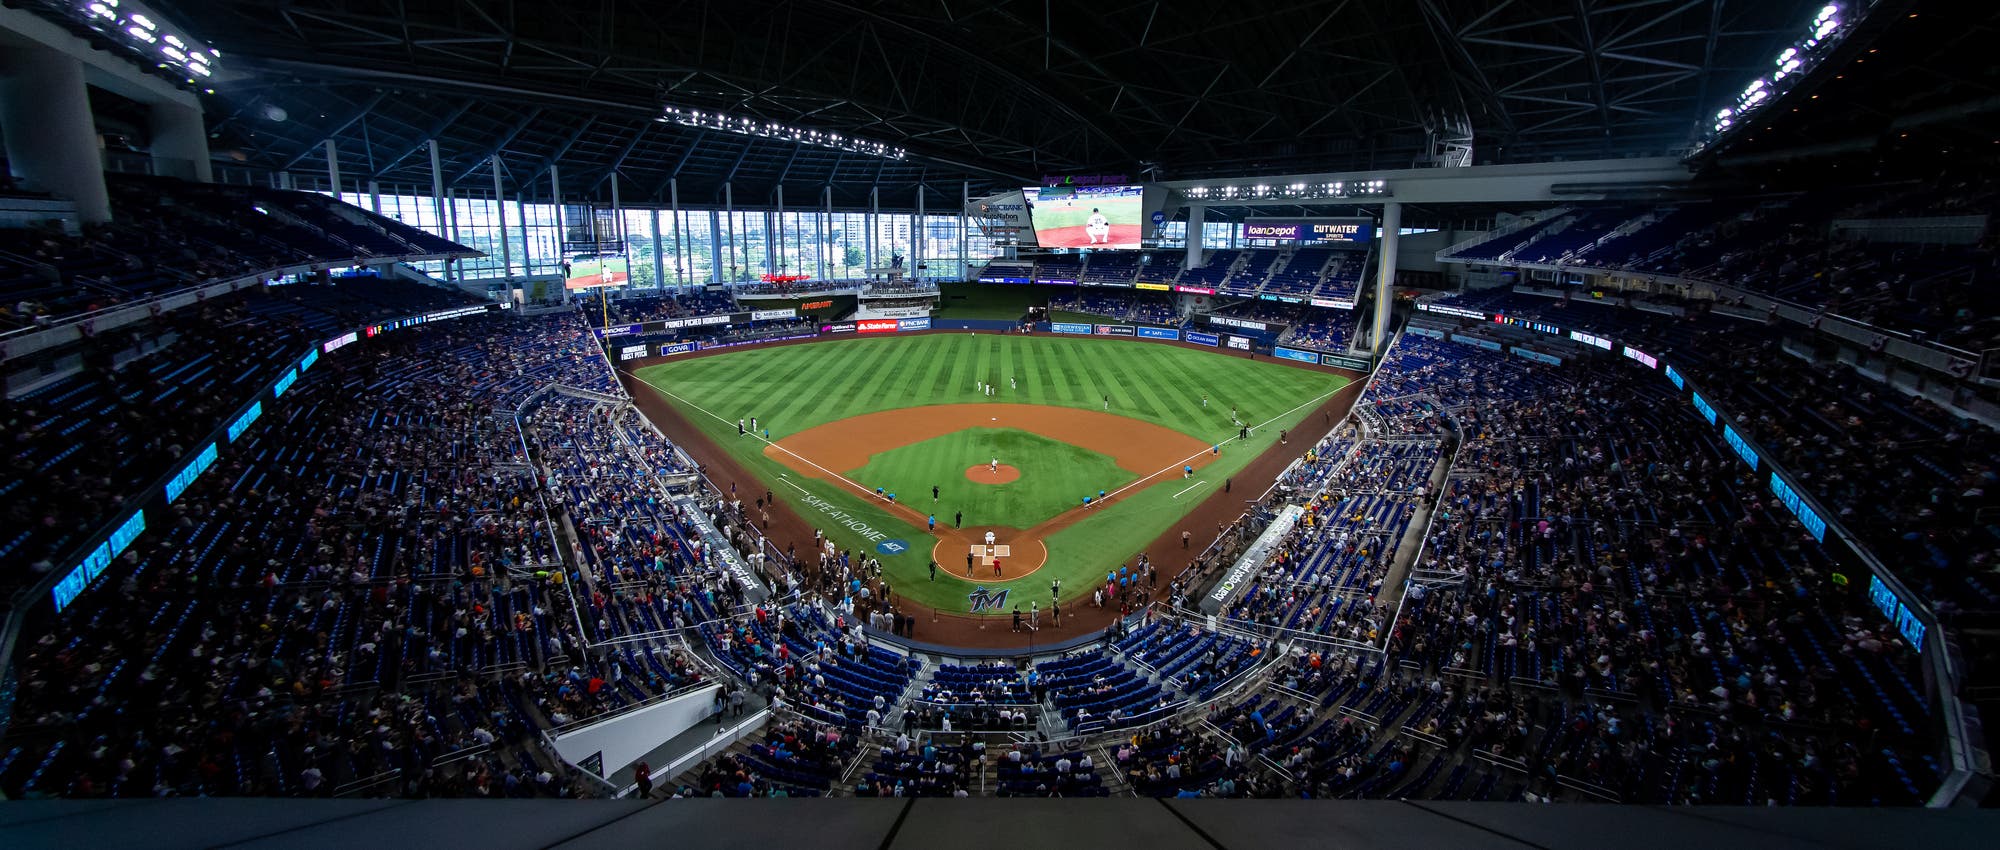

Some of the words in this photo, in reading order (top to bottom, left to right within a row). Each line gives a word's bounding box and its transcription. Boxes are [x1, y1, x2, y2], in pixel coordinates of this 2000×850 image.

[1248, 226, 1298, 237] loanDepot
[1314, 224, 1358, 234] CUTWATER
[665, 320, 684, 329] PRIMER
[668, 345, 688, 354] GOYA
[801, 495, 836, 513] SAFE
[827, 510, 850, 520] AT
[841, 516, 888, 542] HOME
[882, 542, 905, 552] ADT
[1211, 568, 1246, 602] loanDepot
[1241, 557, 1256, 573] park
